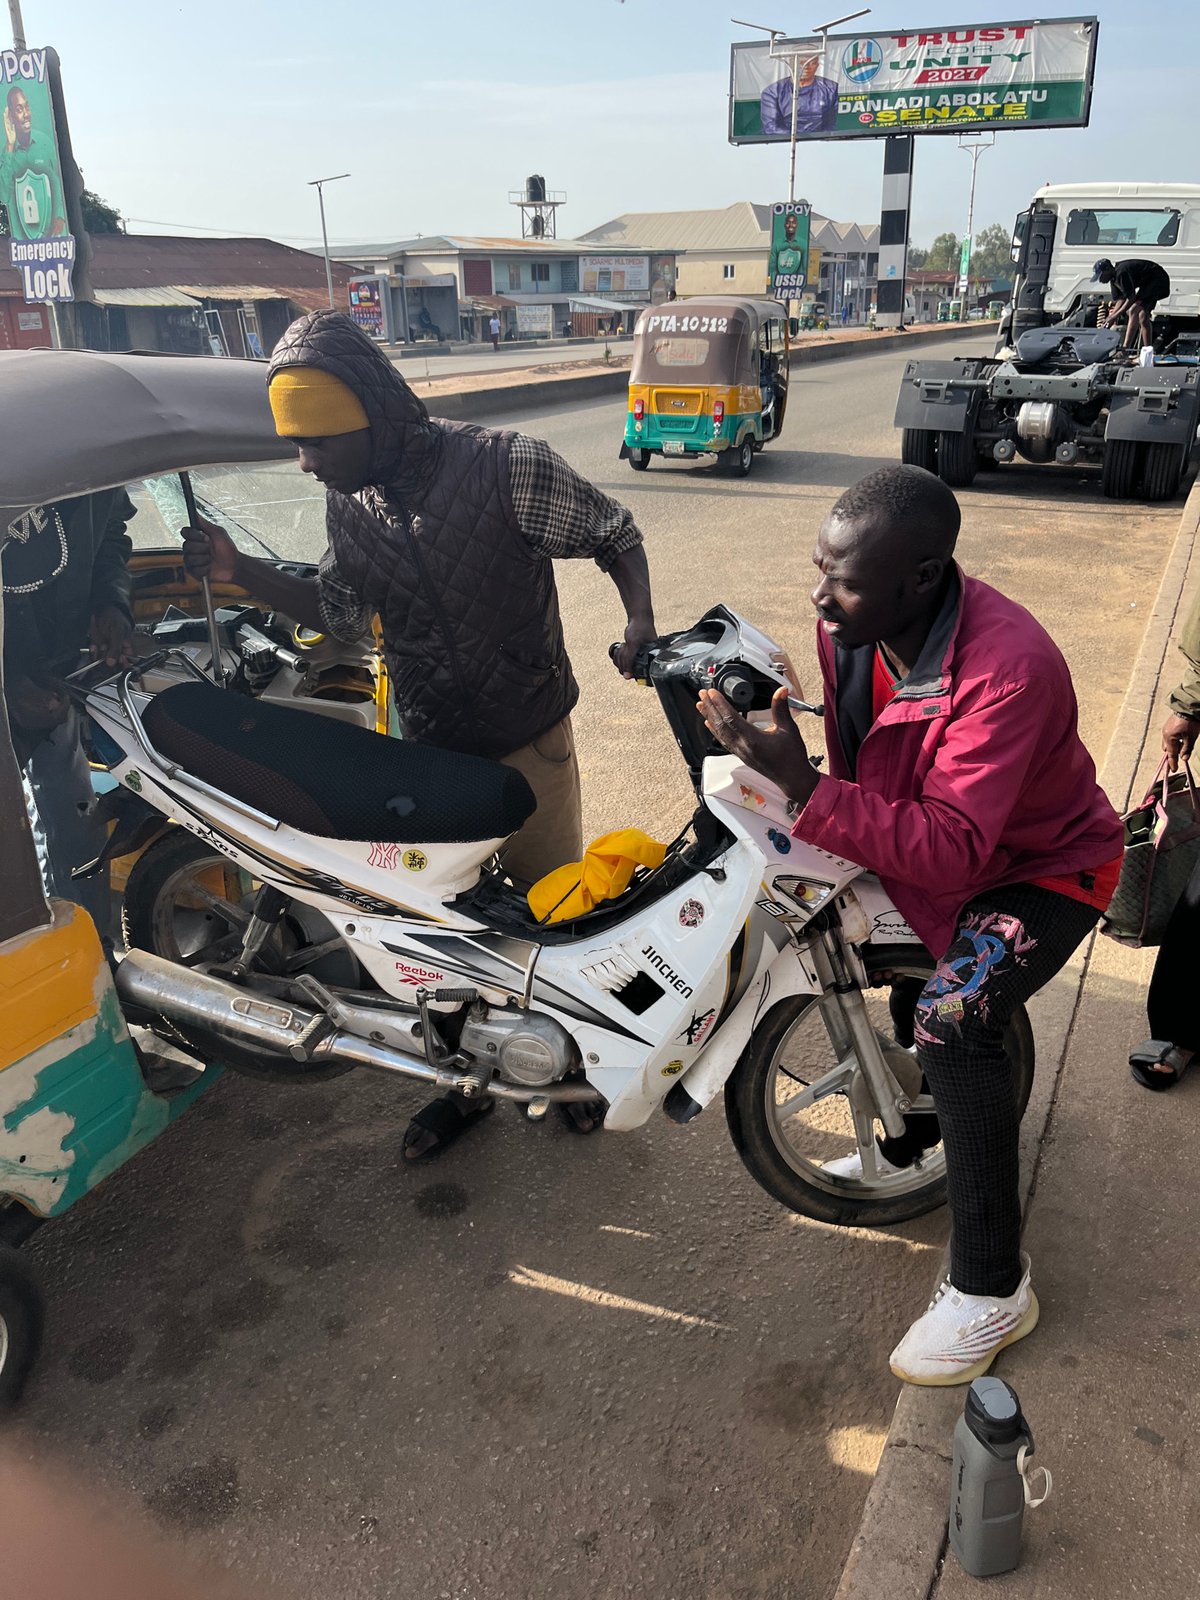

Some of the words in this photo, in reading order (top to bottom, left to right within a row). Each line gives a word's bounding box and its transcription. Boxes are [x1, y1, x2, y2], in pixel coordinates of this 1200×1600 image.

[891, 26, 1033, 48] TRUST
[927, 45, 993, 55] FOR
[0, 50, 47, 82] Pay
[889, 52, 1032, 70] UNITY
[928, 69, 979, 81] 2027
[837, 96, 930, 114] DANLADI
[936, 92, 998, 107] ABOK
[1002, 89, 1048, 103] ATU
[876, 103, 1027, 123] SENATE
[773, 203, 812, 216] OPay
[11, 240, 73, 262] Emergency
[24, 263, 72, 298] Lock
[775, 274, 805, 287] USSD
[395, 962, 444, 981] Reebok
[641, 945, 694, 999] JINCHEN
